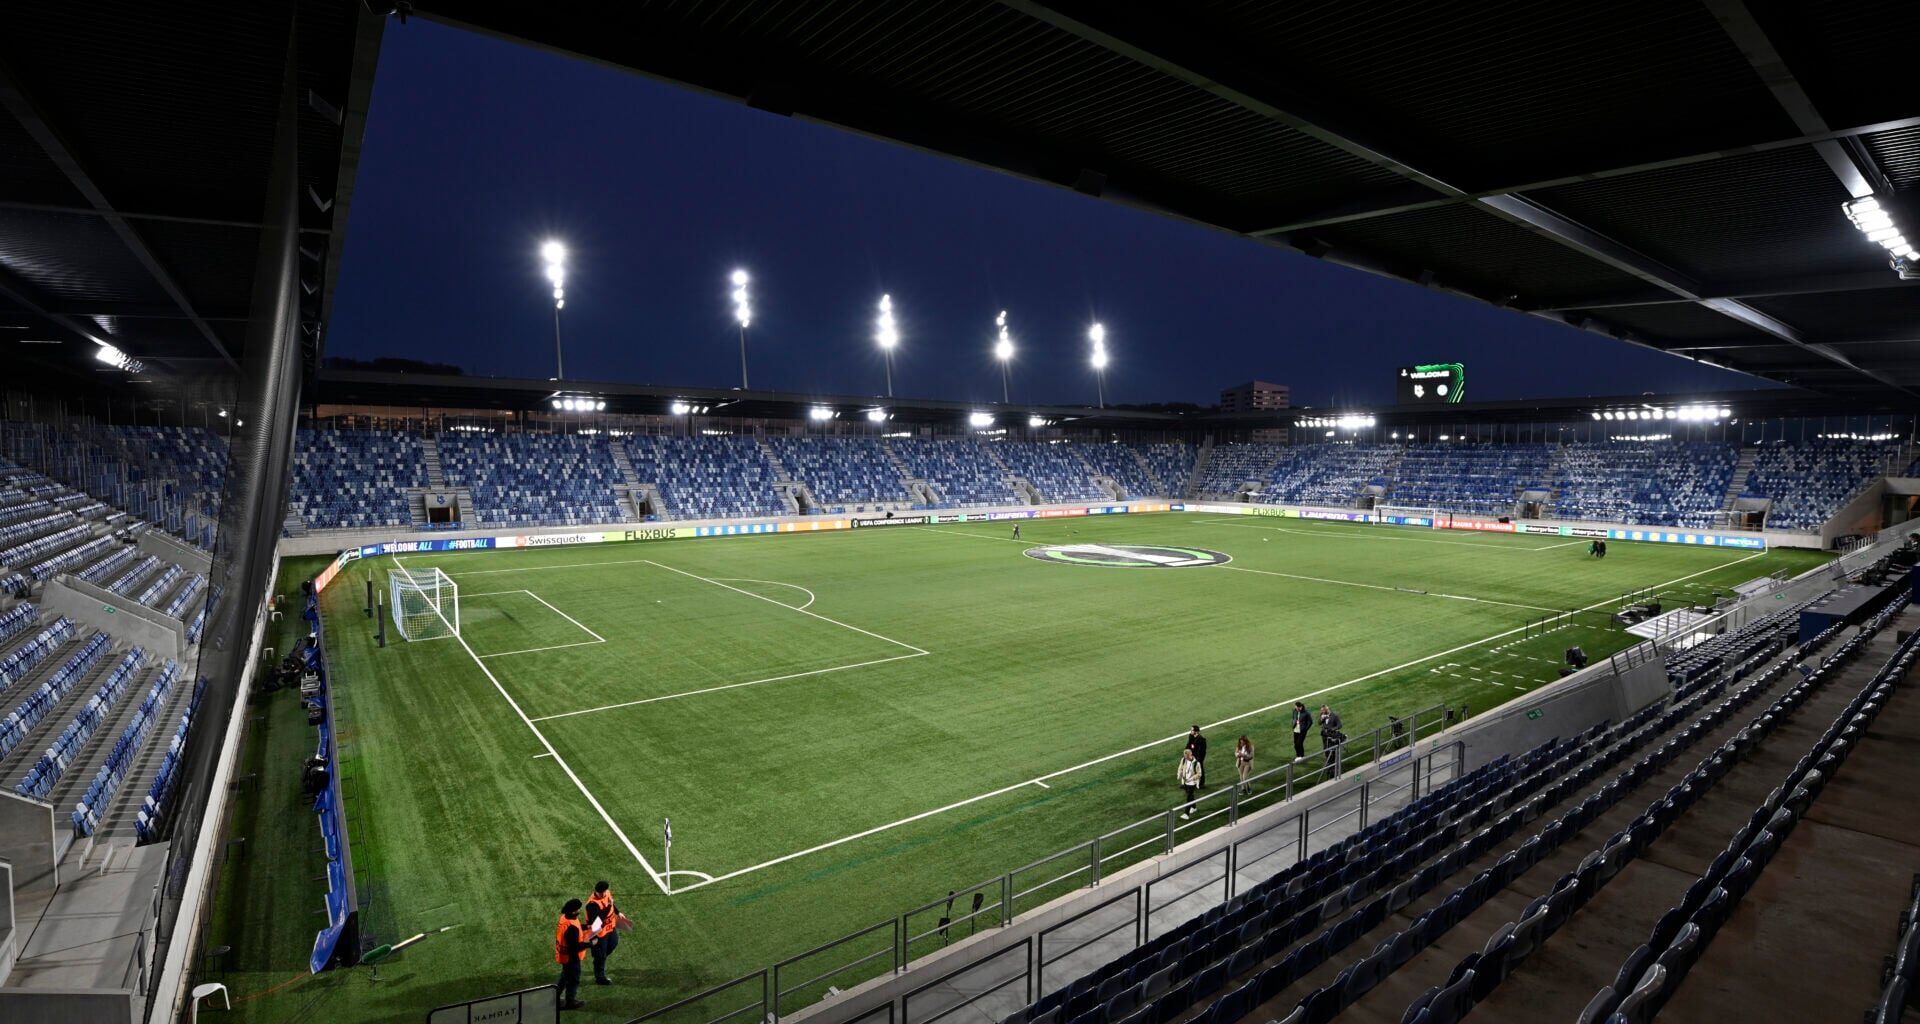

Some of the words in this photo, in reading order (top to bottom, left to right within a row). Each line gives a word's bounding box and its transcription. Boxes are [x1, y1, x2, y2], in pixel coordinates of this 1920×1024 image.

[1410, 371, 1450, 379] WELCOME
[448, 539, 488, 549] #FOOTBALL
[528, 535, 586, 546] Swissquote
[383, 542, 418, 553] WELCOME
[418, 541, 433, 551] ALL
